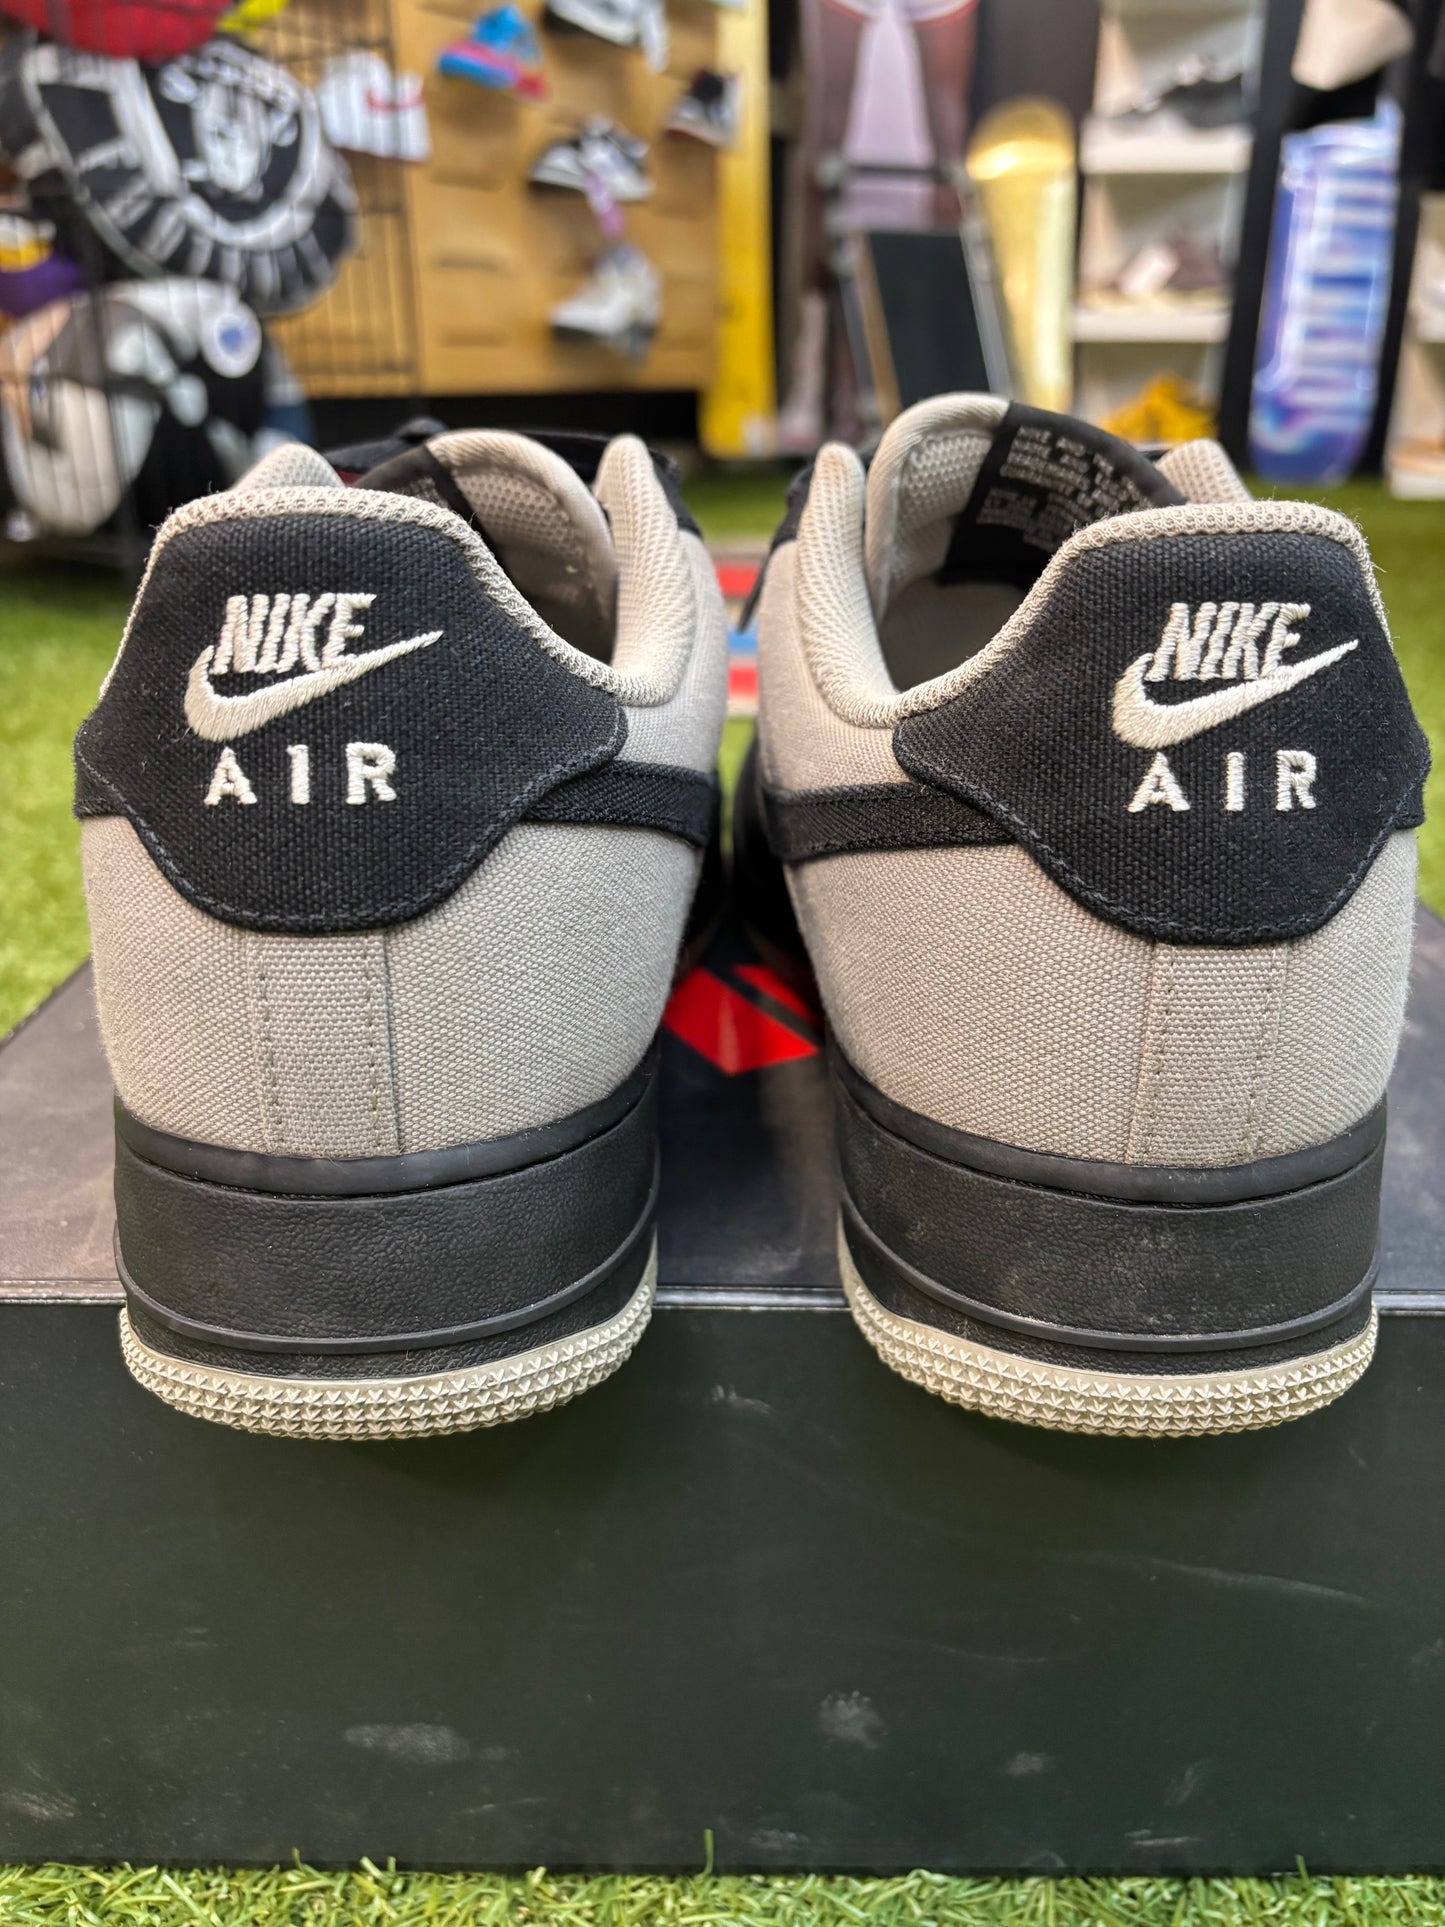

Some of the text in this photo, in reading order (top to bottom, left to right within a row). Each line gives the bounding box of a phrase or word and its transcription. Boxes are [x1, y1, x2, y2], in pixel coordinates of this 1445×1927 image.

[209, 592, 377, 673] NIKE
[1144, 602, 1311, 681] NIKE
[204, 741, 396, 805] AIR
[1127, 750, 1316, 812] AIR
